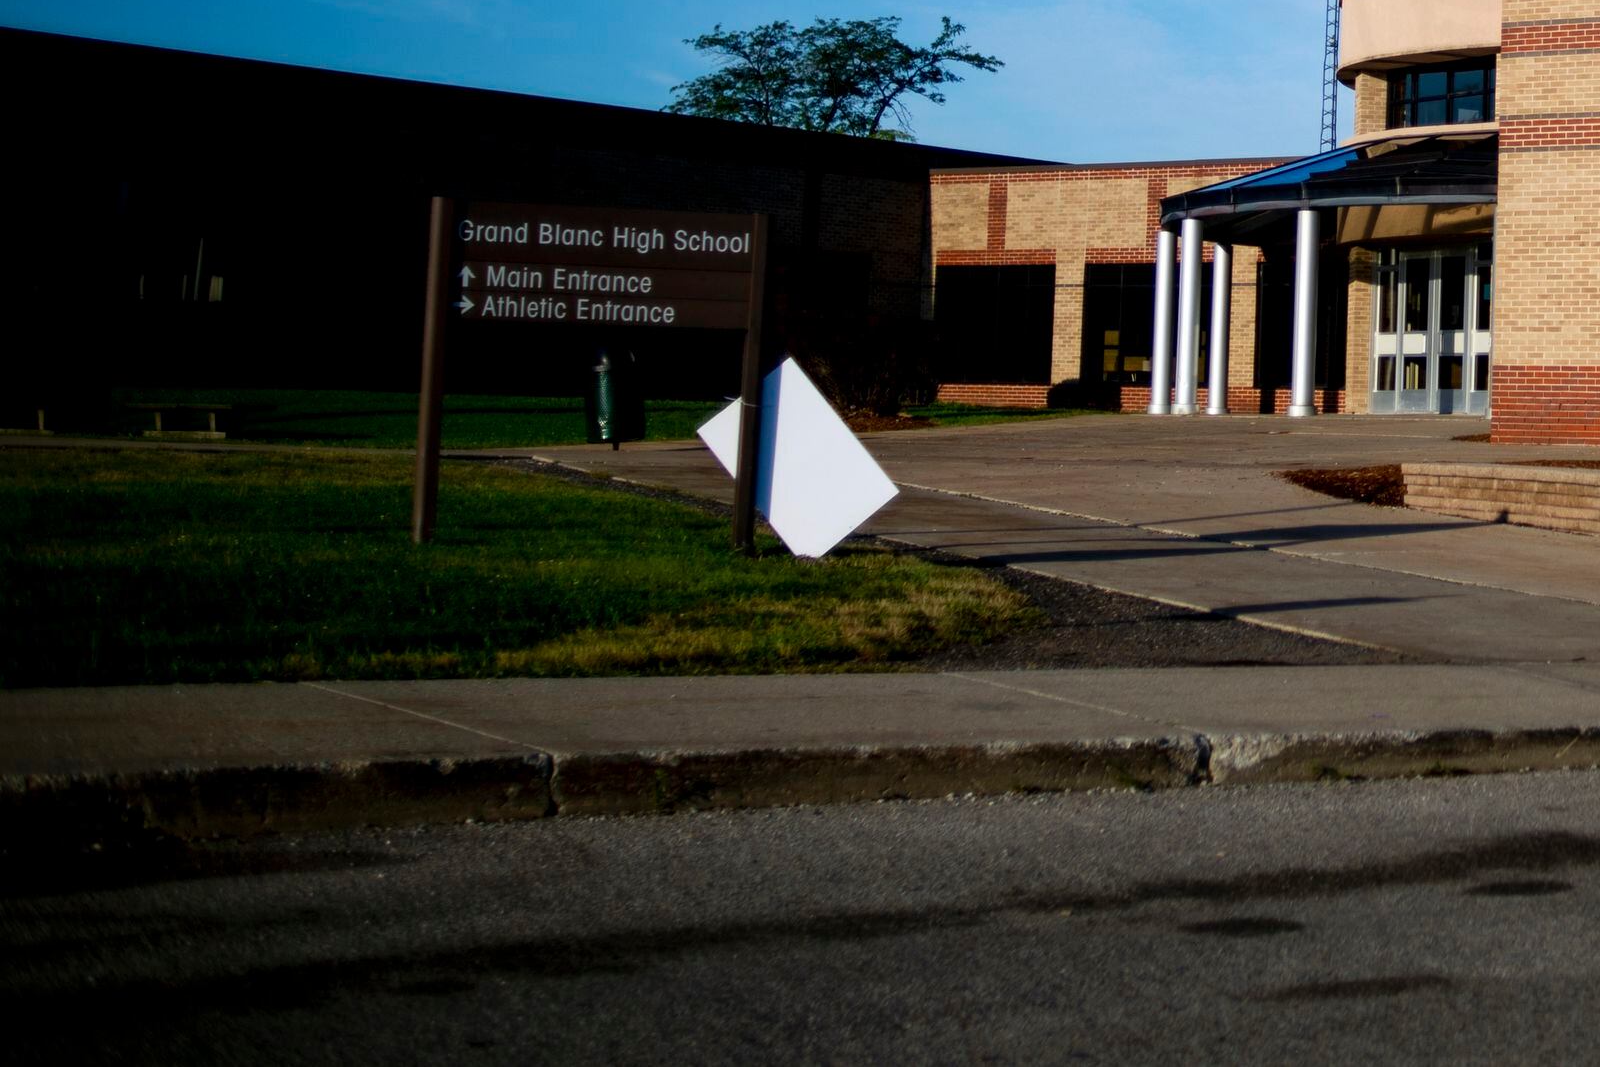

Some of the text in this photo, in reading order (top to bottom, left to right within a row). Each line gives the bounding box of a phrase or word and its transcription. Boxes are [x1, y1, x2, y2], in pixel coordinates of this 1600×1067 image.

[459, 219, 750, 254] Grand Blanc High School
[486, 265, 652, 294] Main Entrance
[481, 295, 675, 324] Athletic Entrance
